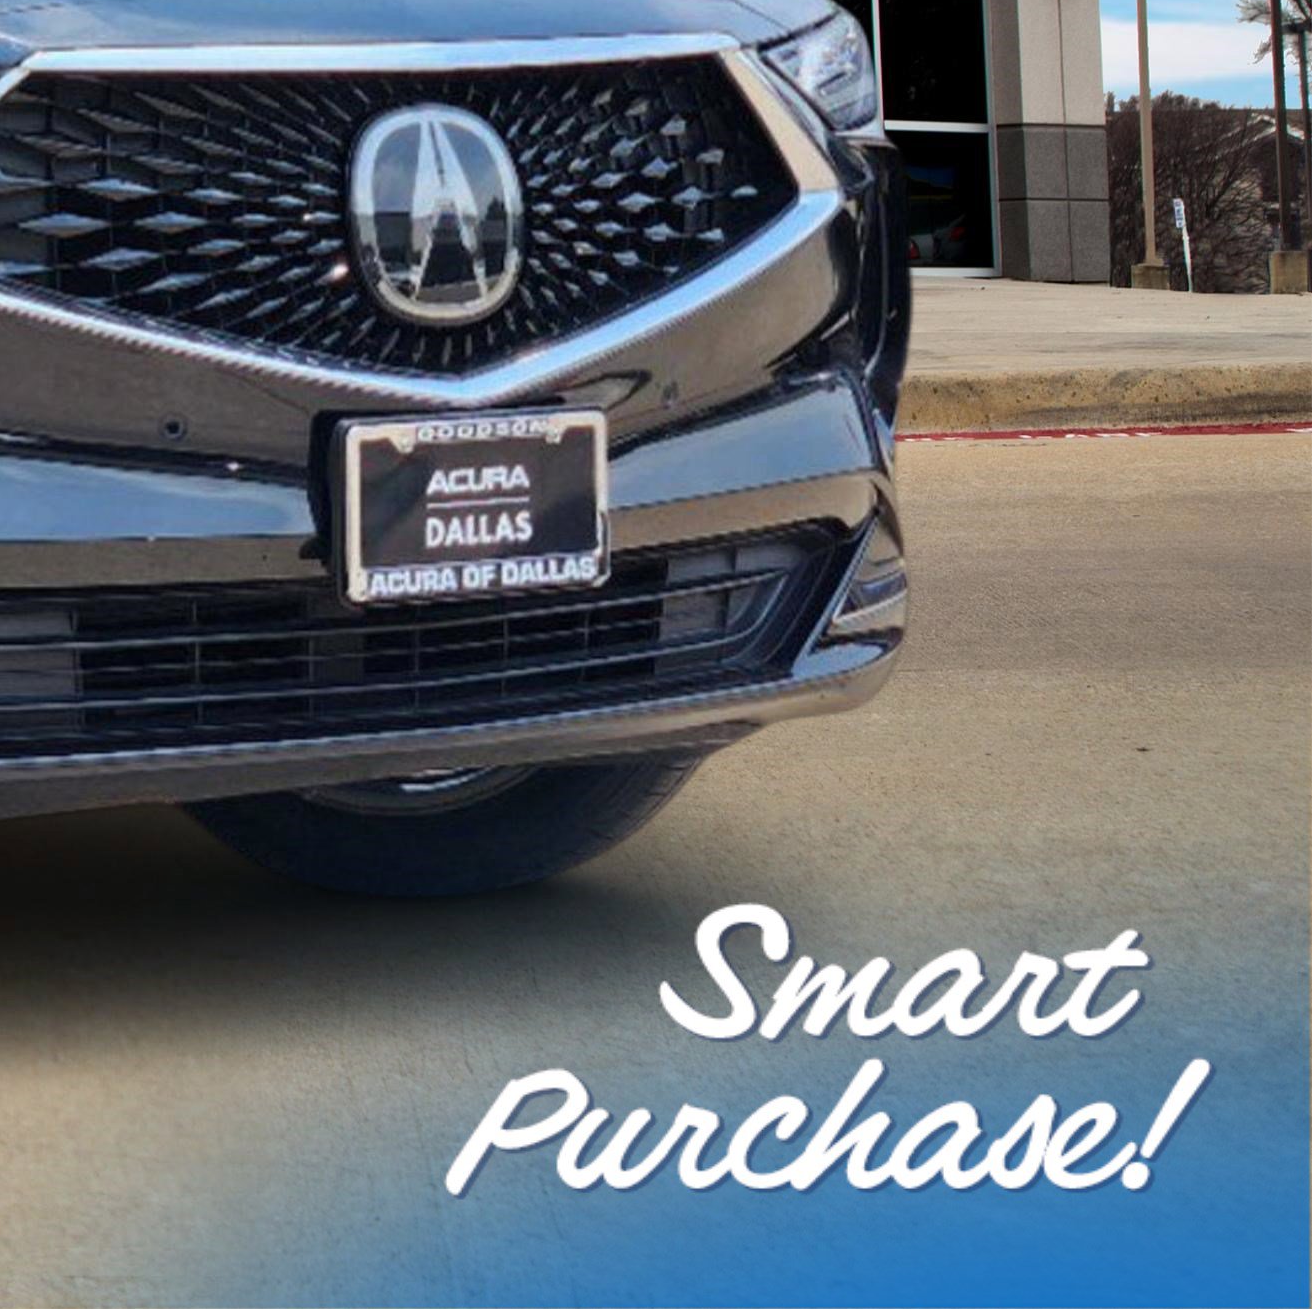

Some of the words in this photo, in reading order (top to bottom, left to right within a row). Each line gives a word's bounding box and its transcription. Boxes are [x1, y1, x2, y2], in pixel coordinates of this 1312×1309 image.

[426, 464, 530, 494] ACURA
[425, 511, 533, 548] DALLAS
[370, 568, 458, 595] ACURA
[461, 564, 497, 589] OF
[501, 556, 596, 585] DALLAS
